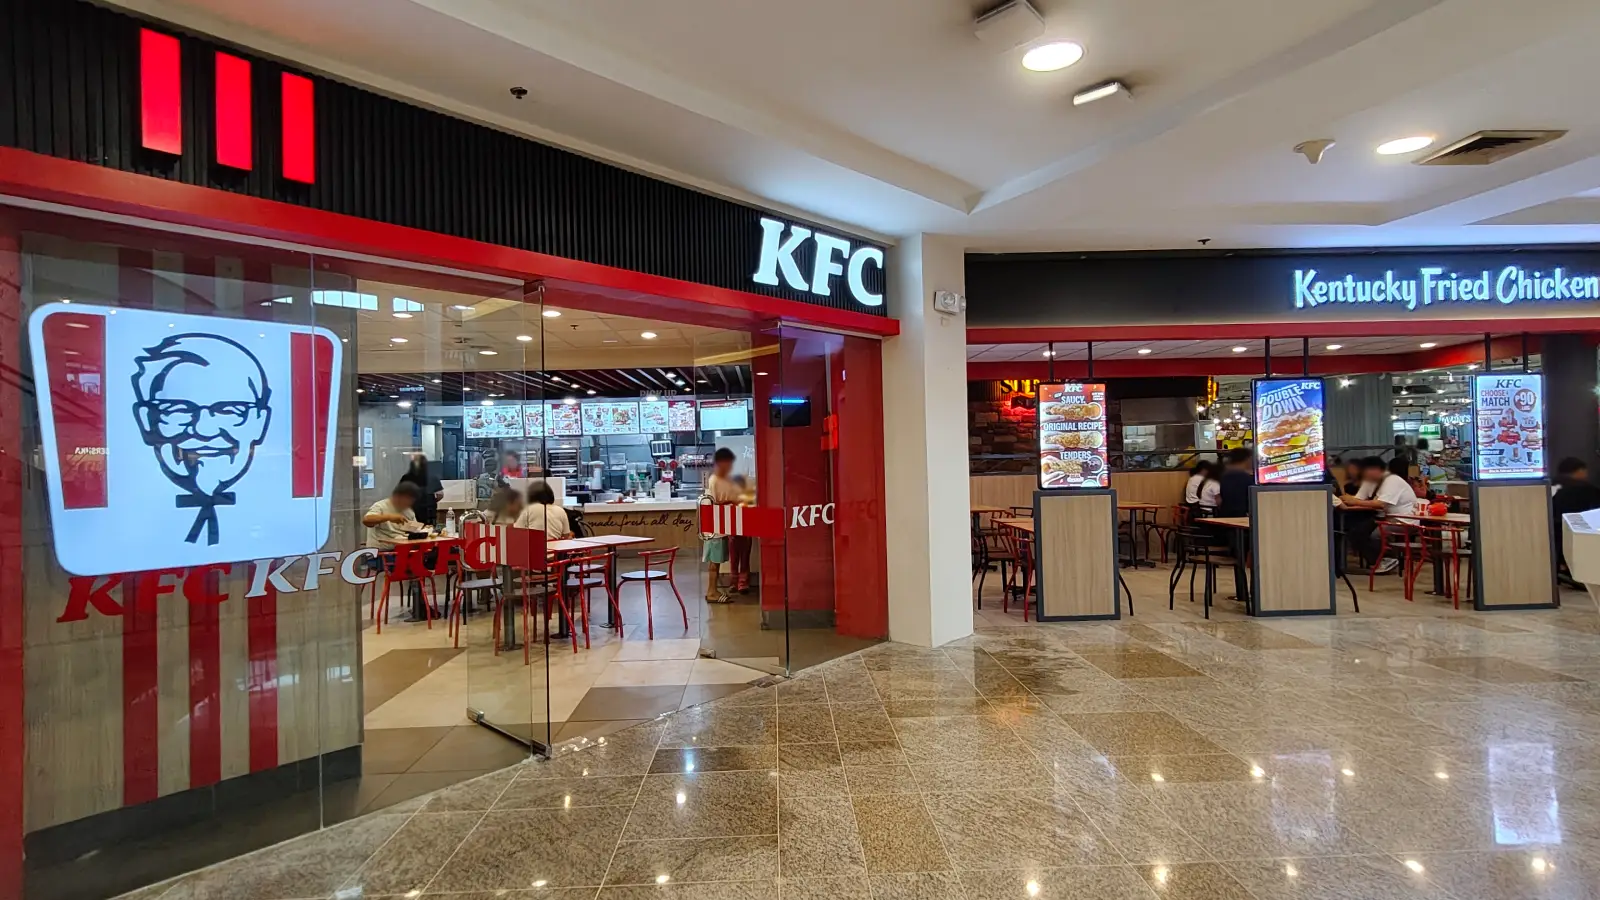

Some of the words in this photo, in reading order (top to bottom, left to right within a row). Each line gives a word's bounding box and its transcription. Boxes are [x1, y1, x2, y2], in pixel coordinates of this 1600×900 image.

[753, 217, 884, 306] KFC
[1293, 269, 1417, 310] Kentucky
[1420, 267, 1489, 305] Fried
[1496, 265, 1600, 304] Chicken
[1064, 383, 1083, 393] KFC
[1301, 382, 1321, 390] KFC
[1496, 379, 1522, 388] KFC
[1259, 386, 1305, 408] DOUBLE
[1262, 395, 1308, 421] DOWN
[1481, 397, 1510, 407] MATCH
[1043, 422, 1077, 431] ORIGINAL
[588, 515, 617, 527] made
[617, 513, 648, 532] fresh
[650, 513, 669, 526] all
[672, 512, 694, 532] day
[790, 502, 835, 529] KFC
[388, 536, 497, 582] KFC
[244, 548, 379, 599] KFC
[56, 563, 232, 624] KFC
